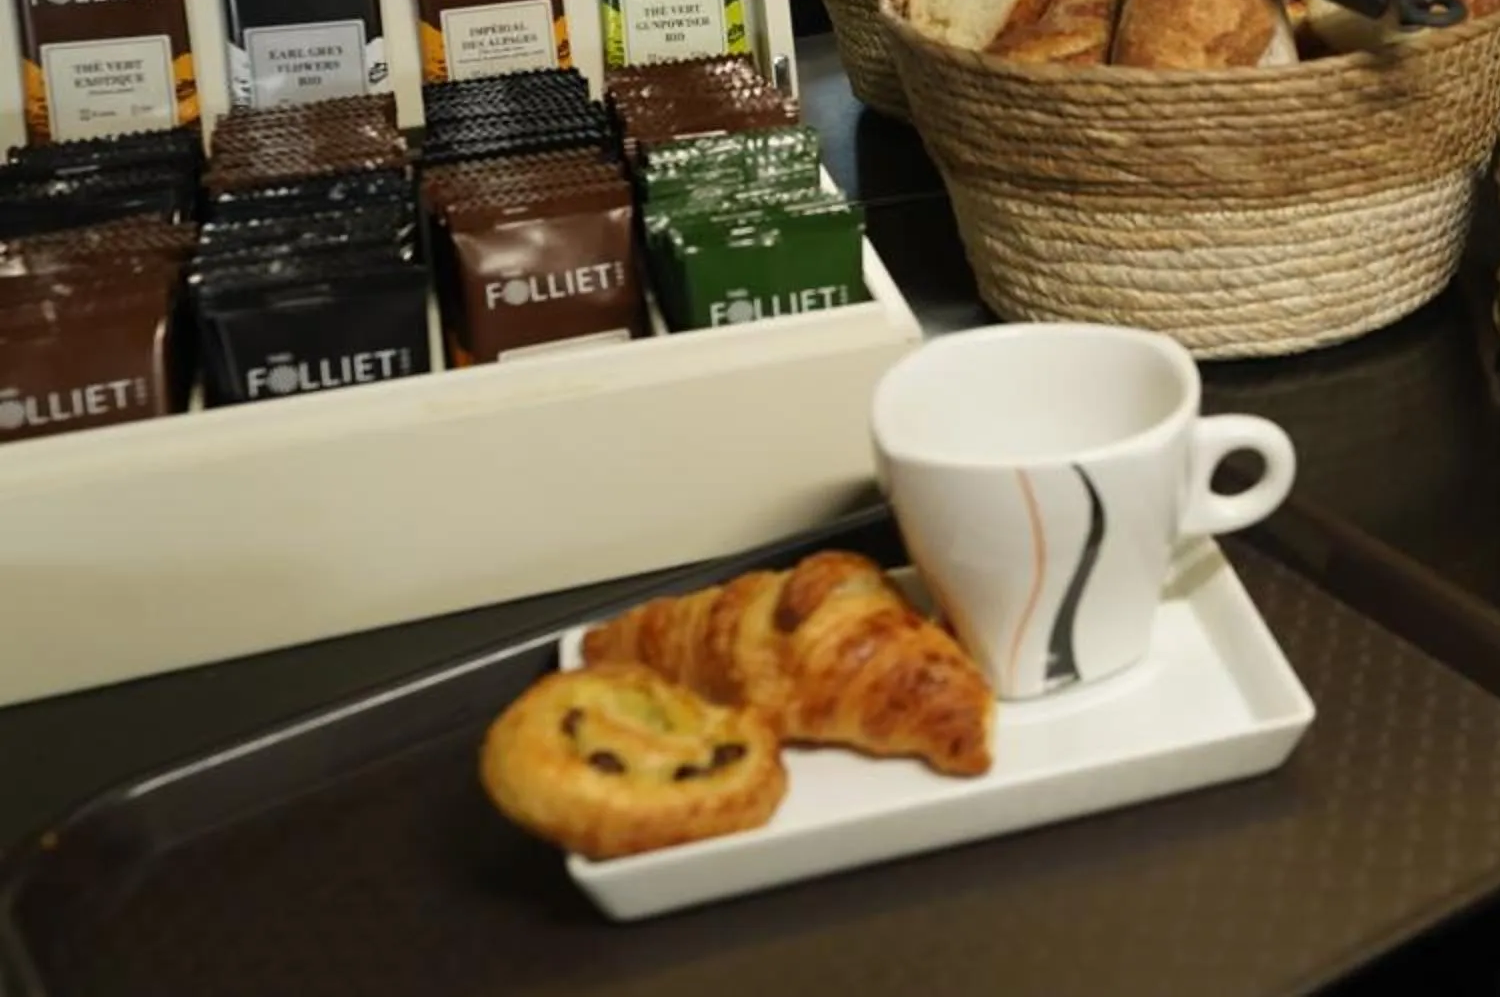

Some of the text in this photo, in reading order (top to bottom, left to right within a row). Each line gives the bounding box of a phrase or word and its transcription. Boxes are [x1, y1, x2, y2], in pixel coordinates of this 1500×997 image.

[485, 262, 611, 310] FOLLIET
[247, 350, 396, 399] FOLLIET
[0, 379, 131, 430] OLLIET
